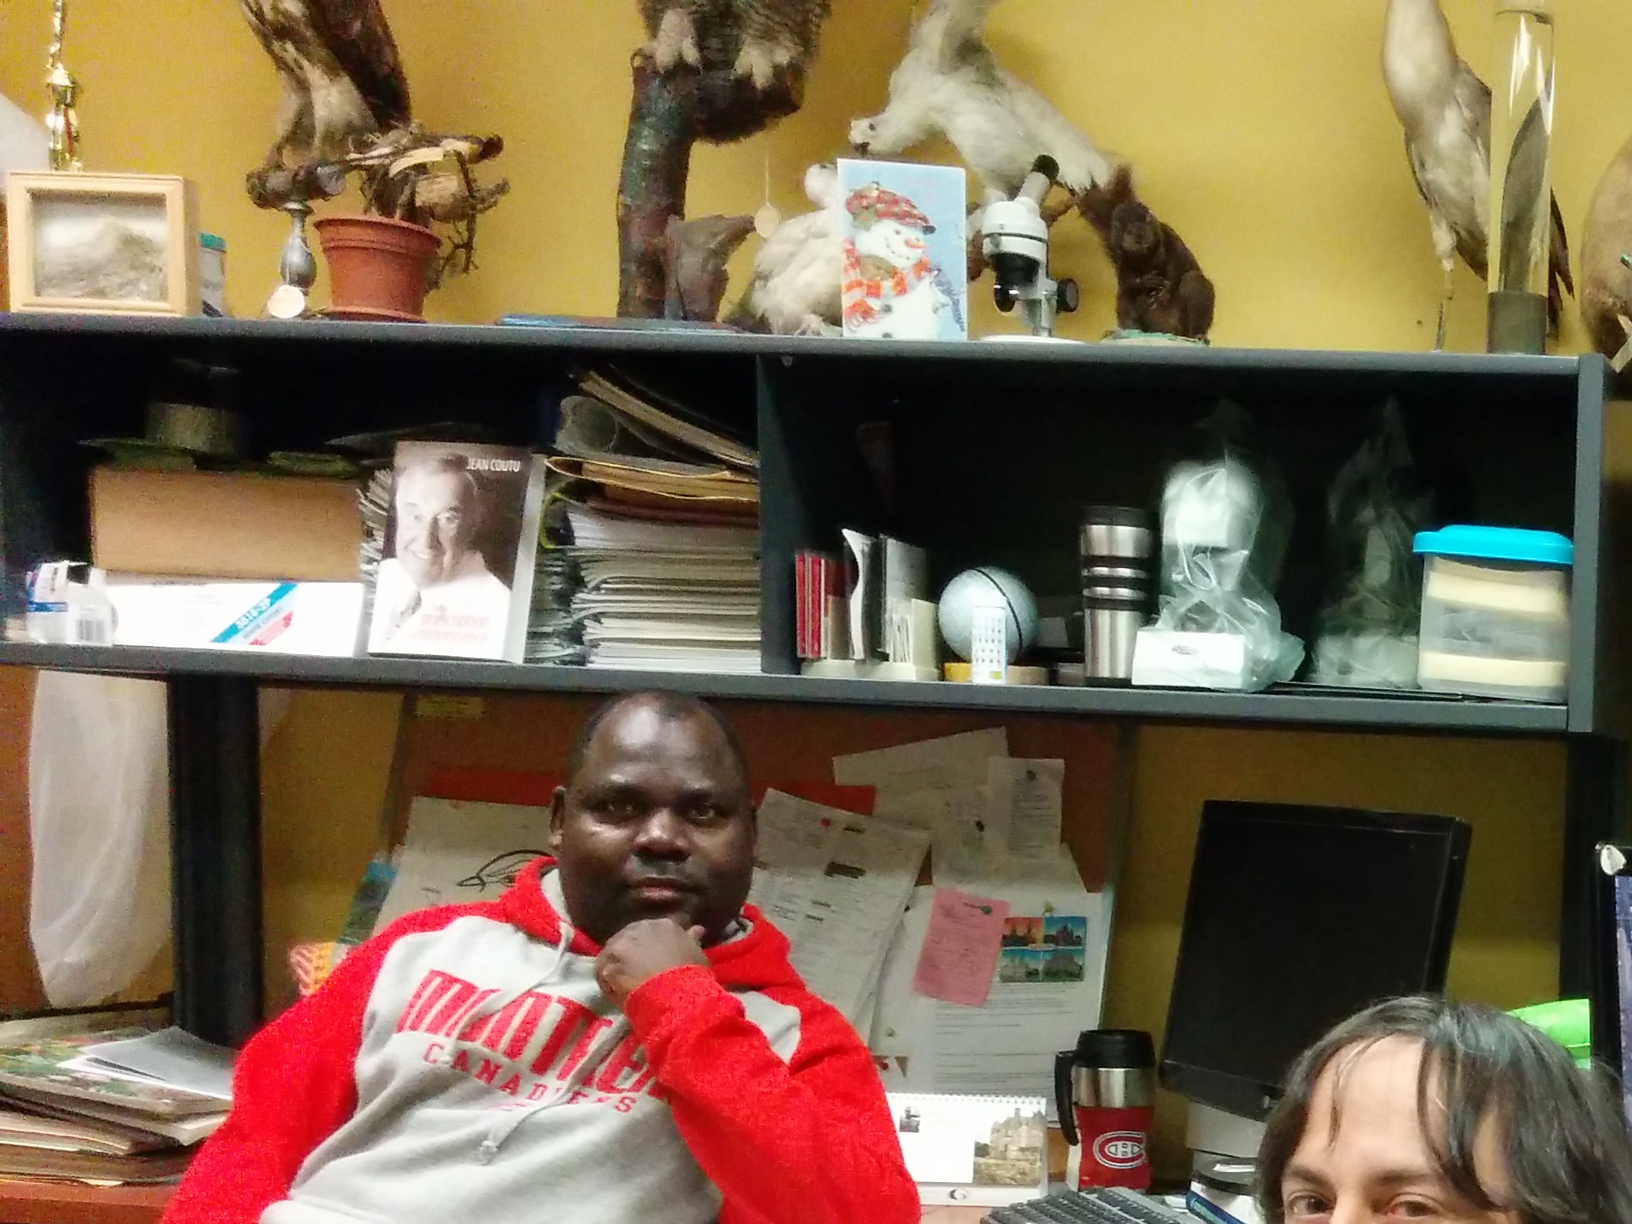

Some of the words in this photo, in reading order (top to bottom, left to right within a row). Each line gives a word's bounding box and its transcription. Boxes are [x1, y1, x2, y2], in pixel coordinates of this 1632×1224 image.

[466, 458, 489, 470] JEAN
[490, 459, 521, 472] COUTU
[402, 1042, 637, 1114] CANADES
